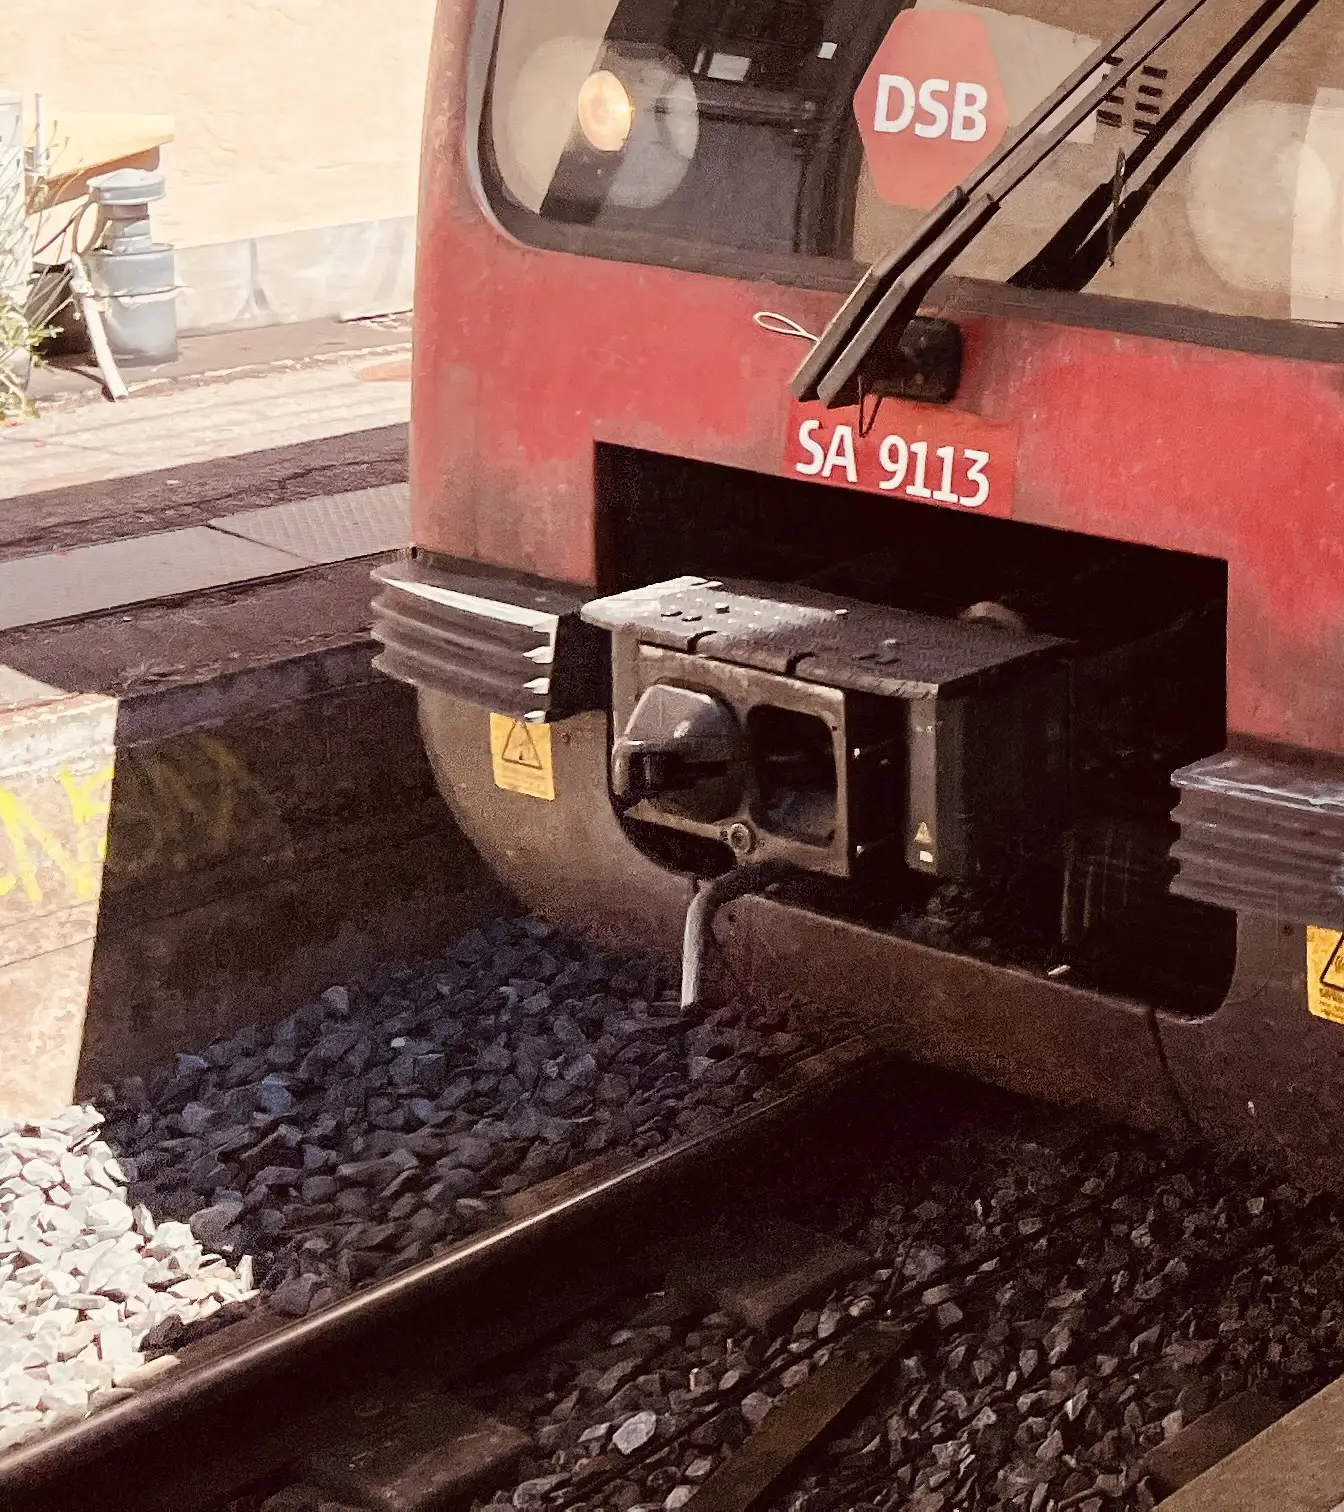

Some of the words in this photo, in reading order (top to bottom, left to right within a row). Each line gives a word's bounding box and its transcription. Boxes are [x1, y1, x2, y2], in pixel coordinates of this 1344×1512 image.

[874, 74, 988, 142] DSB
[796, 419, 858, 483] SA
[878, 434, 990, 508] 9113
